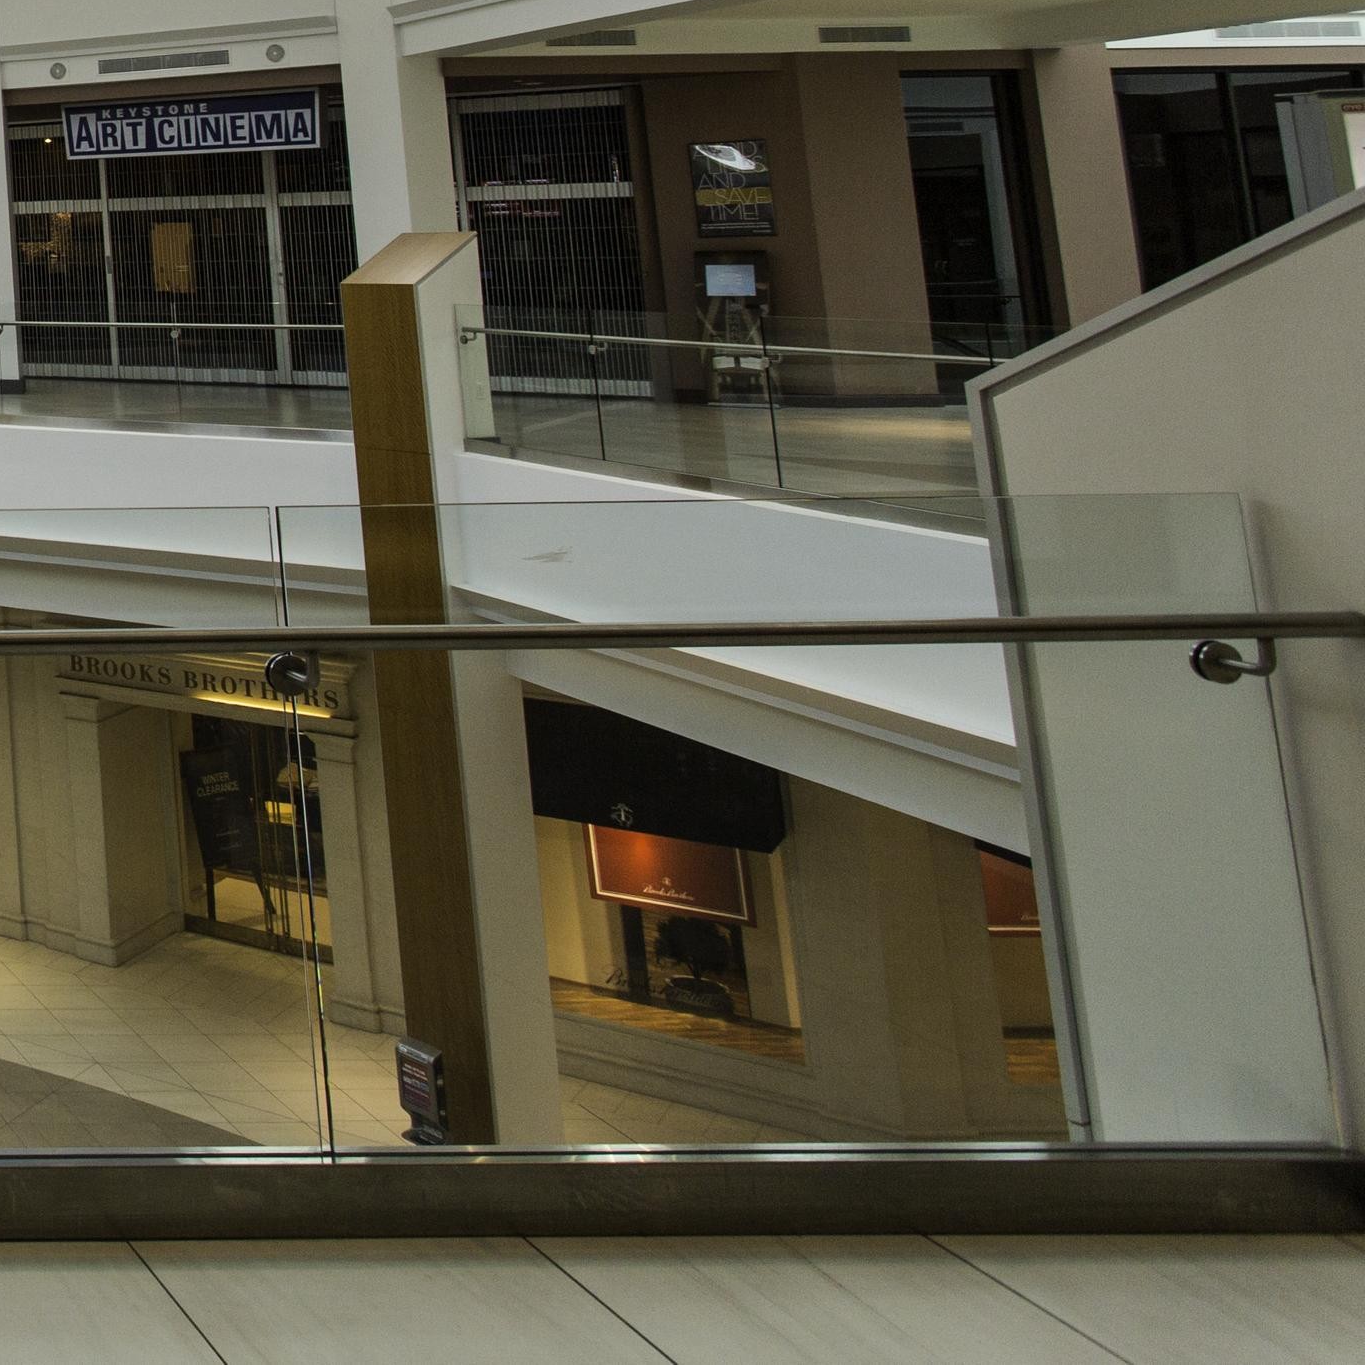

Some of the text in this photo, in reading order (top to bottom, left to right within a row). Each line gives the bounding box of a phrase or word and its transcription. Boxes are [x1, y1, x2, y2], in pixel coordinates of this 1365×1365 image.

[101, 102, 209, 120] KEYSTONE
[74, 110, 311, 151] ART CINEMA
[697, 173, 747, 191] AND
[715, 186, 773, 205] SAVE
[69, 654, 340, 710] BROOKS BROTHRS
